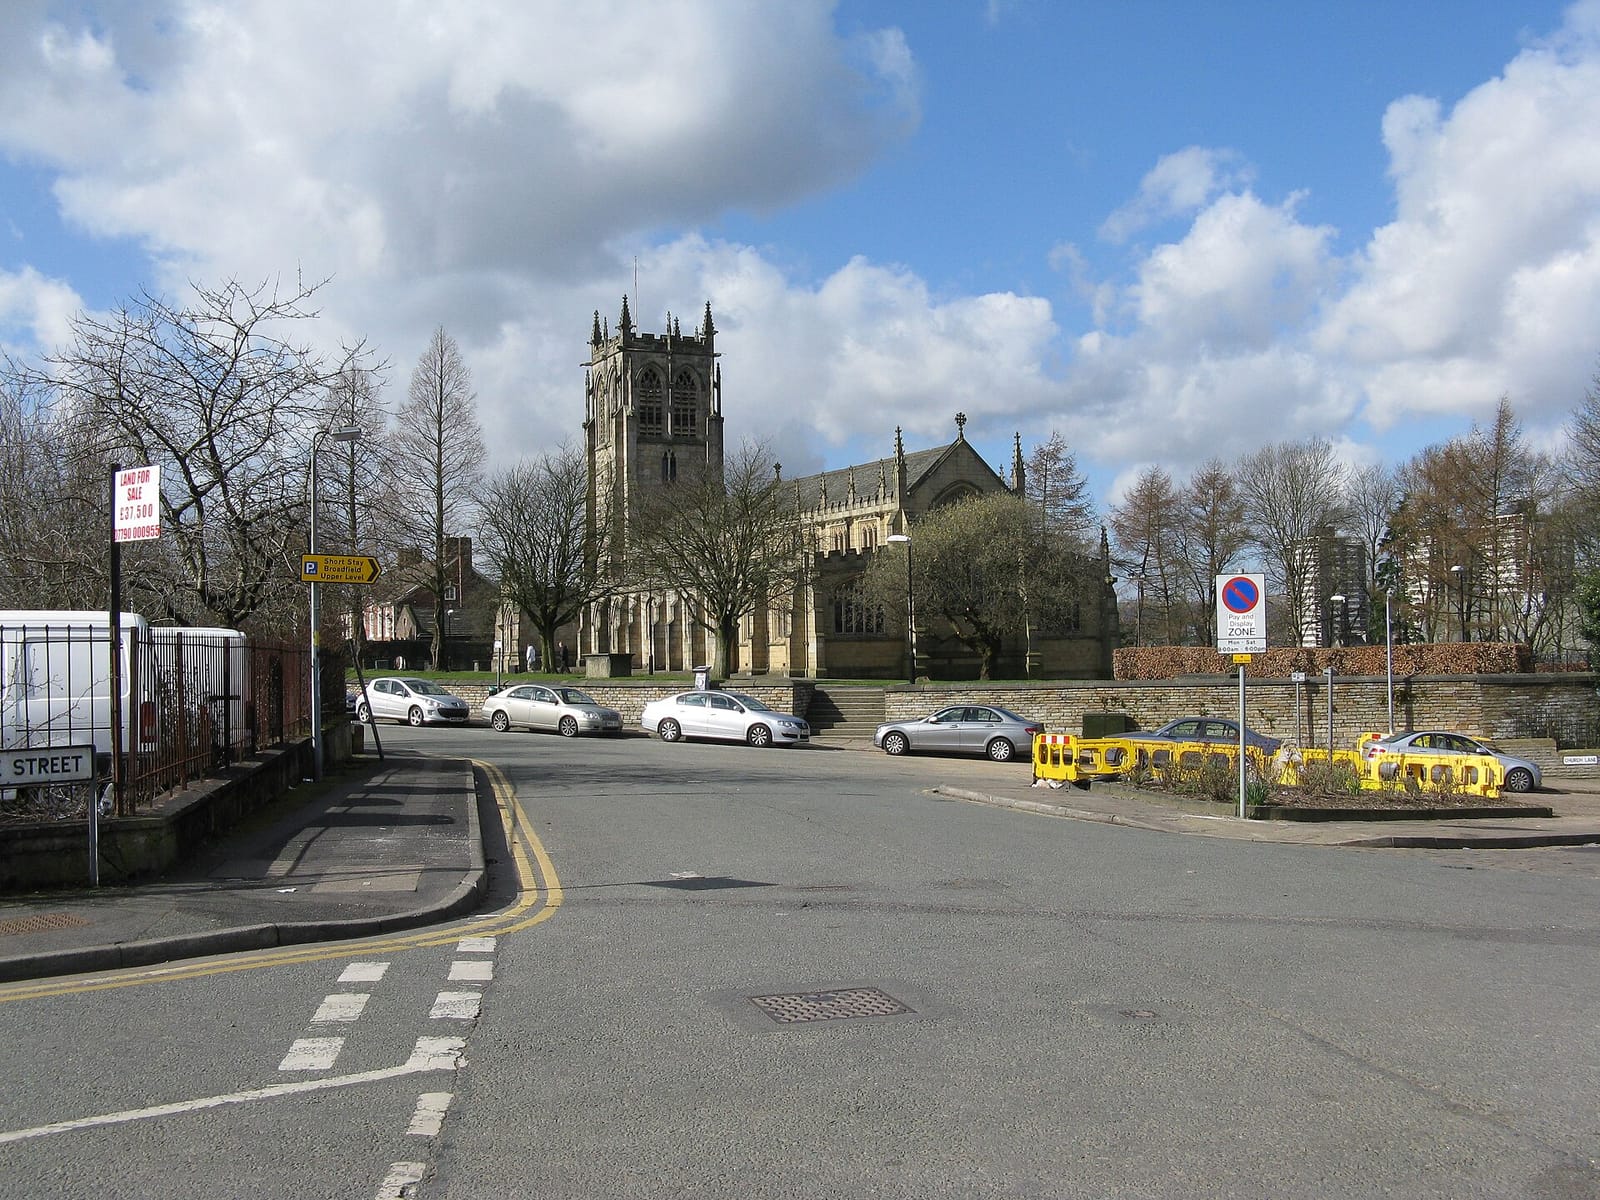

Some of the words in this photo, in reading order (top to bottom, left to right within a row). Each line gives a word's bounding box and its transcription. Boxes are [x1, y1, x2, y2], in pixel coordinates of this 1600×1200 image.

[121, 472, 136, 486] LAND
[137, 470, 150, 483] FOR
[127, 487, 142, 500] SALE
[120, 504, 153, 520] £37,500
[347, 559, 364, 567] Stay
[1228, 628, 1256, 636] ZONE
[13, 756, 83, 776] STREET
